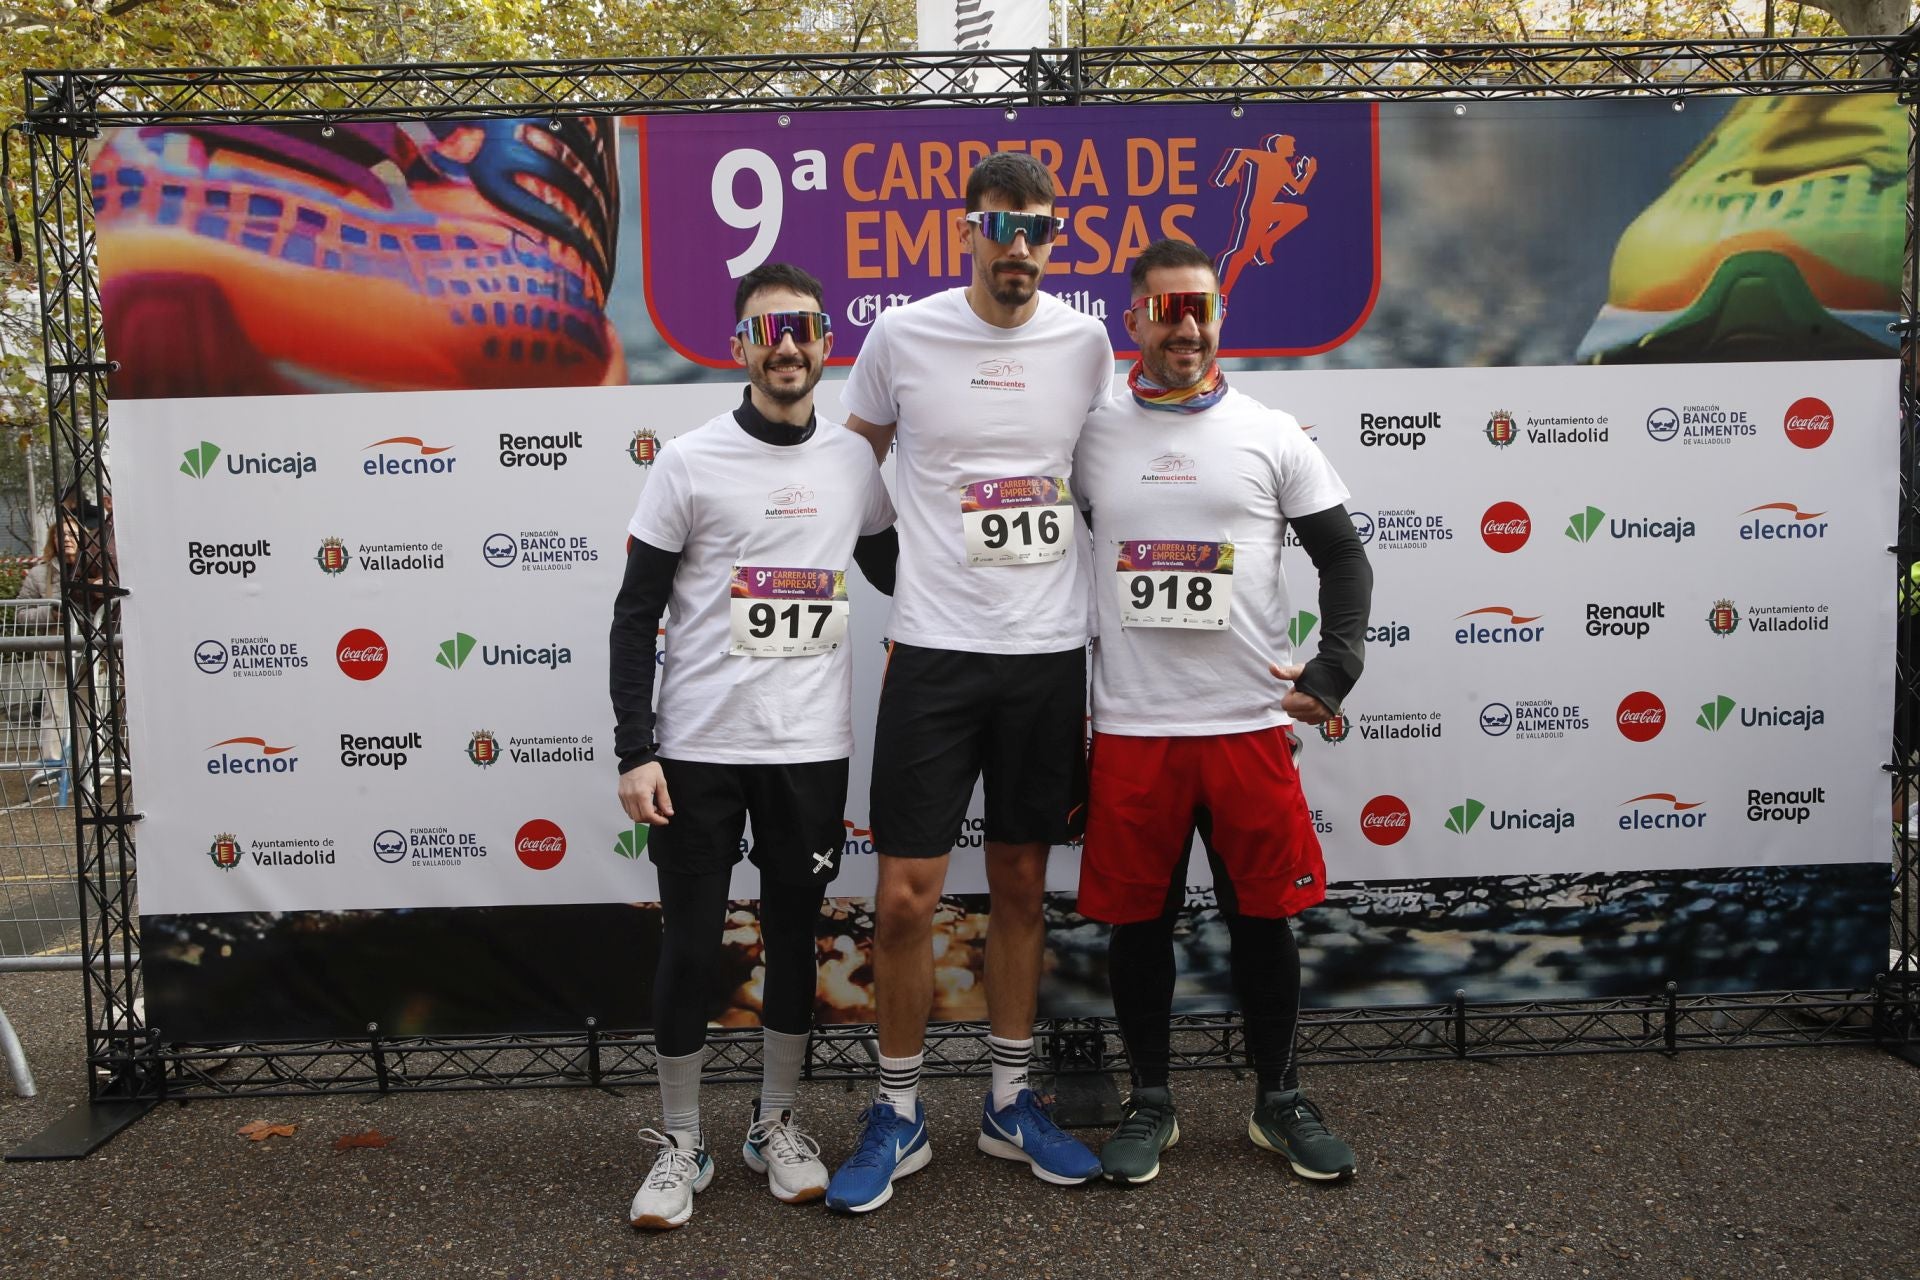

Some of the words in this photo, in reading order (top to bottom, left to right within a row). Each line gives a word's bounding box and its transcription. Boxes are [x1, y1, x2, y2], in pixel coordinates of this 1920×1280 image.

[1126, 137, 1198, 197] DE
[970, 379, 1026, 388] Automucientes
[1684, 404, 1719, 412] FUNDACIÓN
[1361, 412, 1441, 429] Renault
[1527, 417, 1594, 427] Ayuntamiento
[1597, 416, 1608, 424] de
[1683, 412, 1726, 424] BANCO
[1731, 412, 1746, 423] DE
[1527, 428, 1608, 443] Valladolid
[1684, 425, 1756, 437] ALIMENTOS
[500, 432, 582, 450] Renault
[1360, 430, 1426, 450] Group
[227, 452, 316, 479] Unicaja
[364, 454, 456, 475] elecnor
[500, 450, 567, 470] Group
[1000, 480, 1031, 489] CARRERA
[1141, 474, 1197, 482] Automucientes
[1000, 486, 1041, 498] EMPRESAS
[765, 507, 818, 516] Automucientes
[1379, 508, 1415, 516] FUNDACIÓN
[981, 510, 1060, 549] 916
[1379, 517, 1422, 528] BANCO
[1427, 516, 1443, 527] DE
[1740, 519, 1828, 540] elecnor
[521, 529, 558, 537] FUNDACIÓN
[1379, 529, 1452, 541] ALIMENTOS
[1611, 517, 1695, 543] Unicaja
[189, 540, 271, 558] Renault
[359, 543, 428, 554] Ayuntamiento
[431, 542, 442, 550] de
[521, 538, 565, 549] BANCO
[570, 537, 587, 548] DE
[1152, 543, 1185, 552] CARRERA
[1187, 544, 1197, 552] DE
[360, 554, 443, 571] Valladolid
[522, 550, 598, 562] ALIMENTOS
[1152, 551, 1197, 561] EMPRESAS
[189, 559, 256, 578] Group
[772, 571, 806, 580] CARRERA
[807, 571, 817, 580] DE
[772, 579, 817, 589] EMPRESAS
[1130, 575, 1212, 611] 918
[1587, 602, 1664, 620] Renault
[1749, 605, 1814, 616] Ayuntamiento
[1818, 604, 1828, 612] de
[748, 603, 833, 639] 917
[1749, 616, 1828, 632] Valladolid
[1363, 621, 1410, 648] caja
[1456, 623, 1544, 644] elecnor
[1586, 620, 1649, 639] Group
[232, 644, 276, 656] BANCO
[280, 644, 297, 655] DE
[483, 643, 571, 670] Unicaja
[233, 657, 308, 669] ALIMENTOS
[1516, 698, 1552, 706] FUNDACIÓN
[1360, 712, 1427, 723] Ayuntamiento
[1516, 707, 1558, 718] BANCO
[1563, 706, 1579, 717] DE
[1741, 705, 1824, 731] Unicaja
[1360, 723, 1441, 739] Valladolid
[1517, 719, 1589, 731] ALIMENTOS
[341, 733, 422, 750] Renault
[510, 736, 578, 746] Ayuntamiento
[581, 735, 592, 743] de
[341, 751, 407, 770] Group
[510, 747, 593, 763] Valladolid
[207, 754, 298, 774] elecnor
[1748, 788, 1825, 805] Renault
[1491, 808, 1574, 833] Unicaja
[1619, 810, 1706, 830] elecnor
[1747, 806, 1810, 824] Group
[410, 826, 447, 834] FUNDACIÓN
[252, 839, 319, 850] Ayuntamiento
[323, 838, 334, 846] de
[411, 834, 454, 846] BANCO
[459, 834, 476, 844] DE
[252, 850, 335, 865] Valladolid
[412, 846, 486, 858] ALIMENTOS
